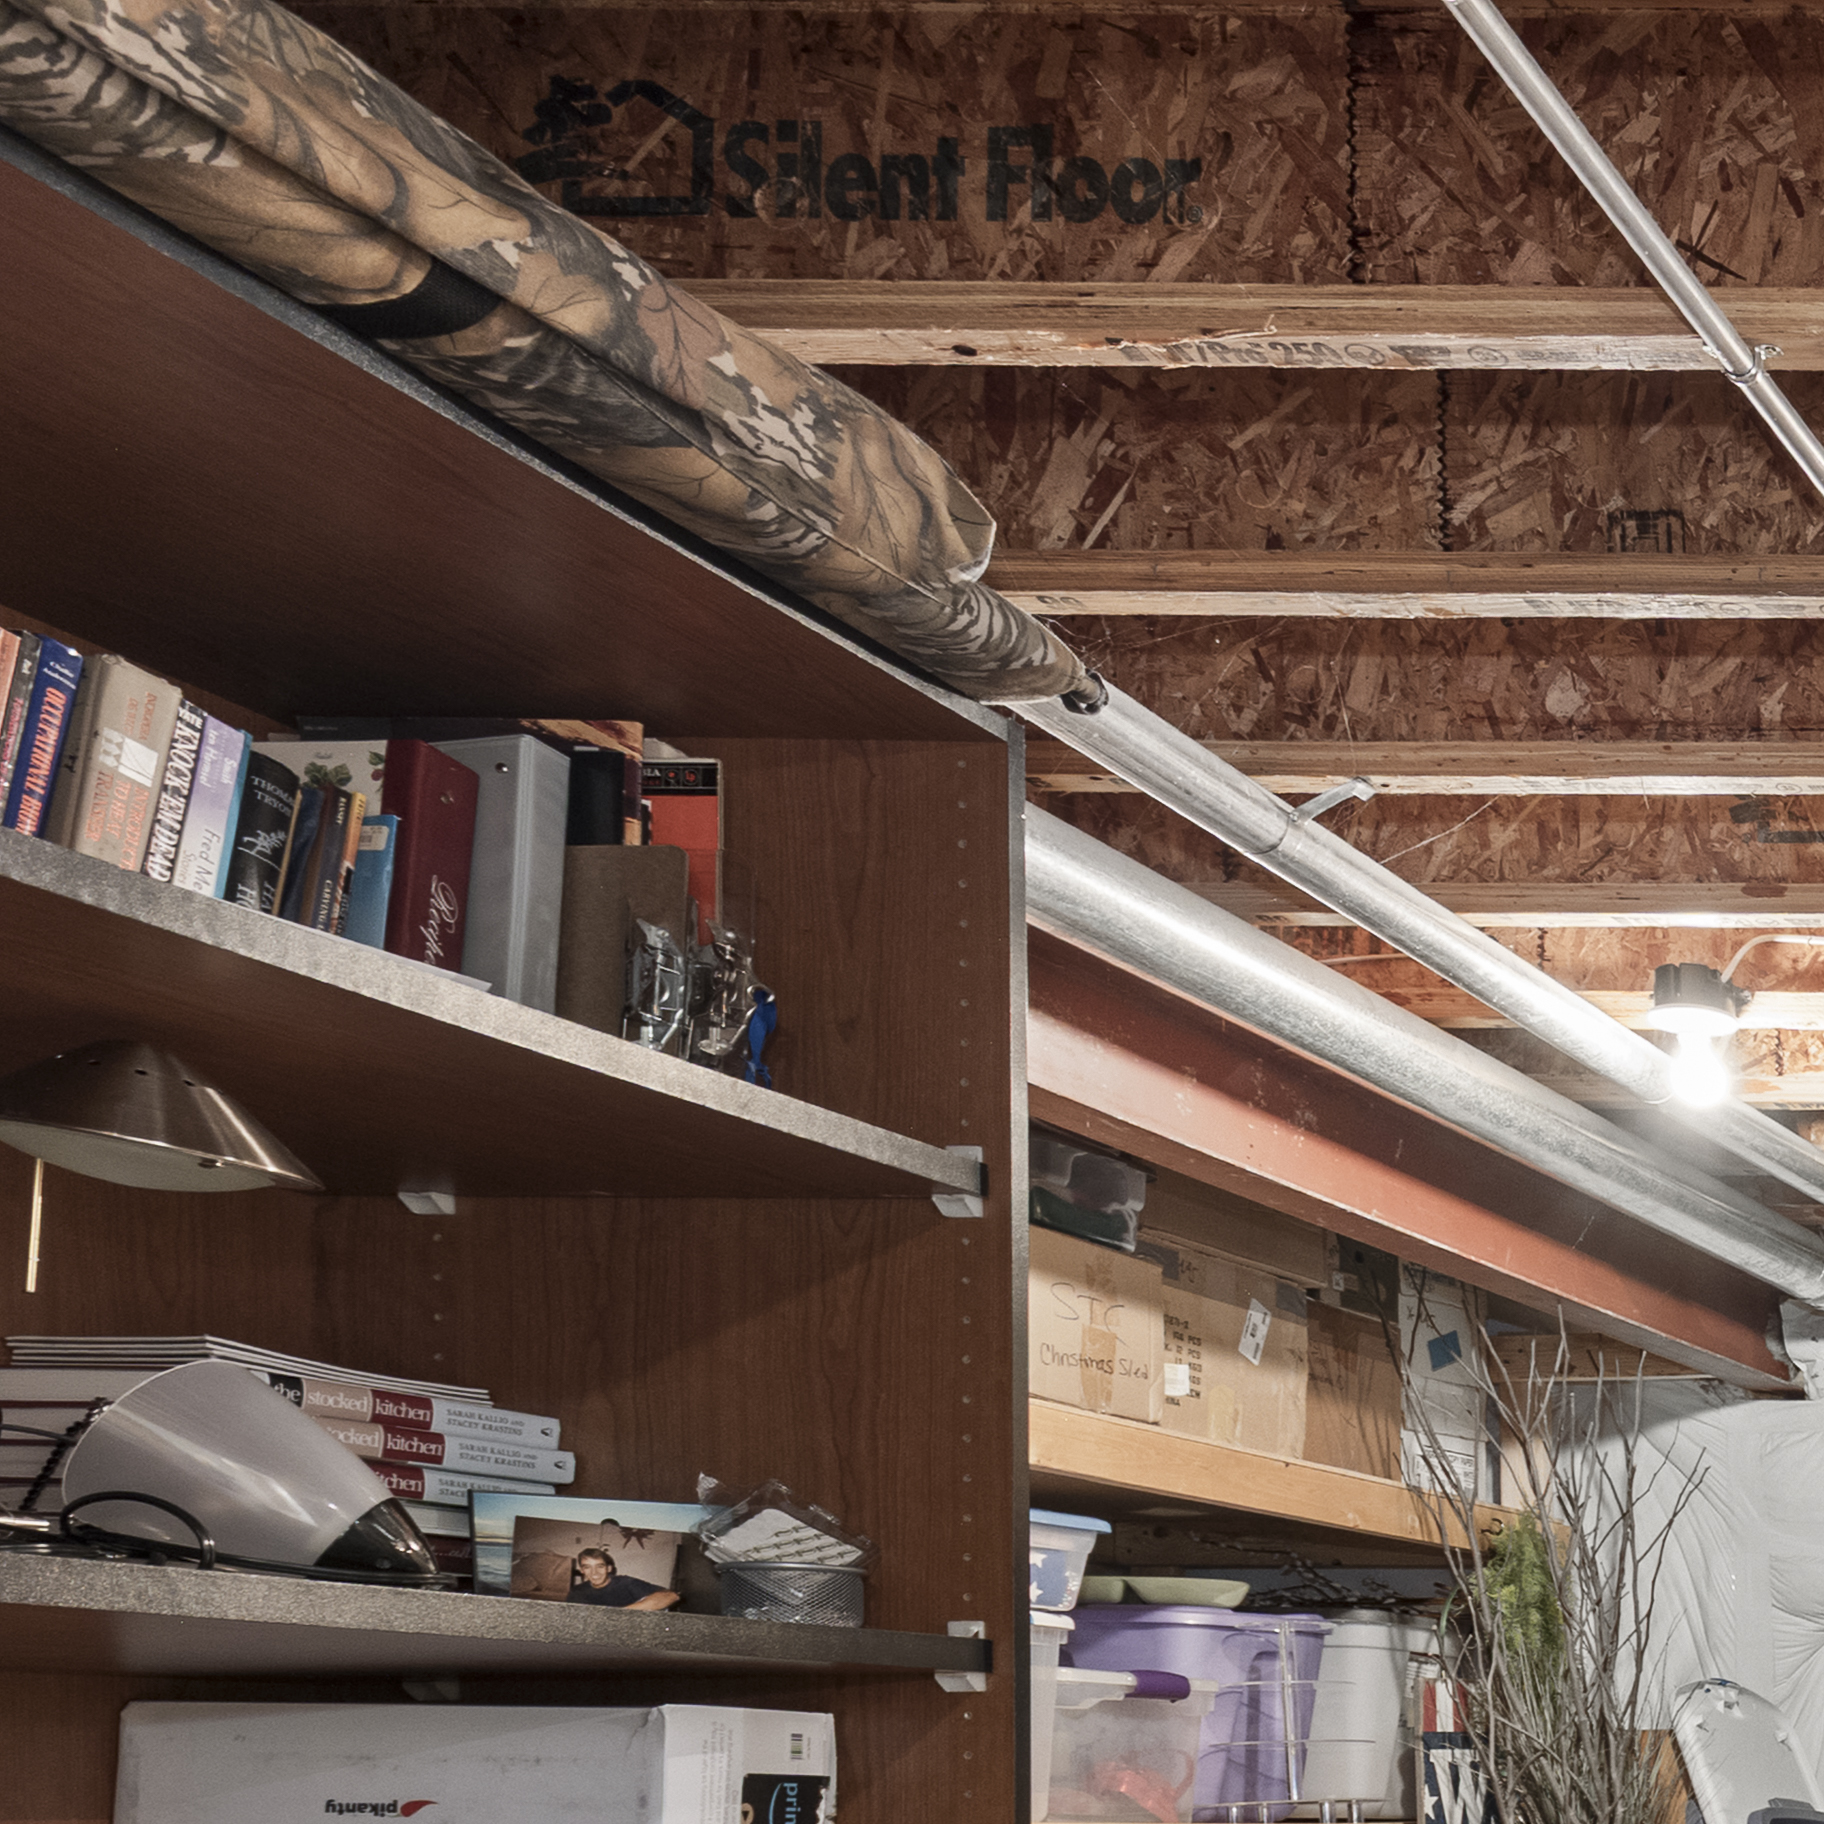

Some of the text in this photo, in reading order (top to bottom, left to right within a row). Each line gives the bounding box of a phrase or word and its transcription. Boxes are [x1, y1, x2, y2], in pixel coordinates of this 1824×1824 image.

[723, 119, 1202, 224] Silent Floor
[25, 687, 67, 795] OCCUPATIONAL
[146, 715, 202, 883] KNOCK DEAD
[201, 827, 221, 863] Fred
[307, 1386, 370, 1413] stocked
[375, 1396, 432, 1425] kitchen
[386, 1429, 445, 1459] kitchen
[324, 1799, 400, 1818] pikanty
